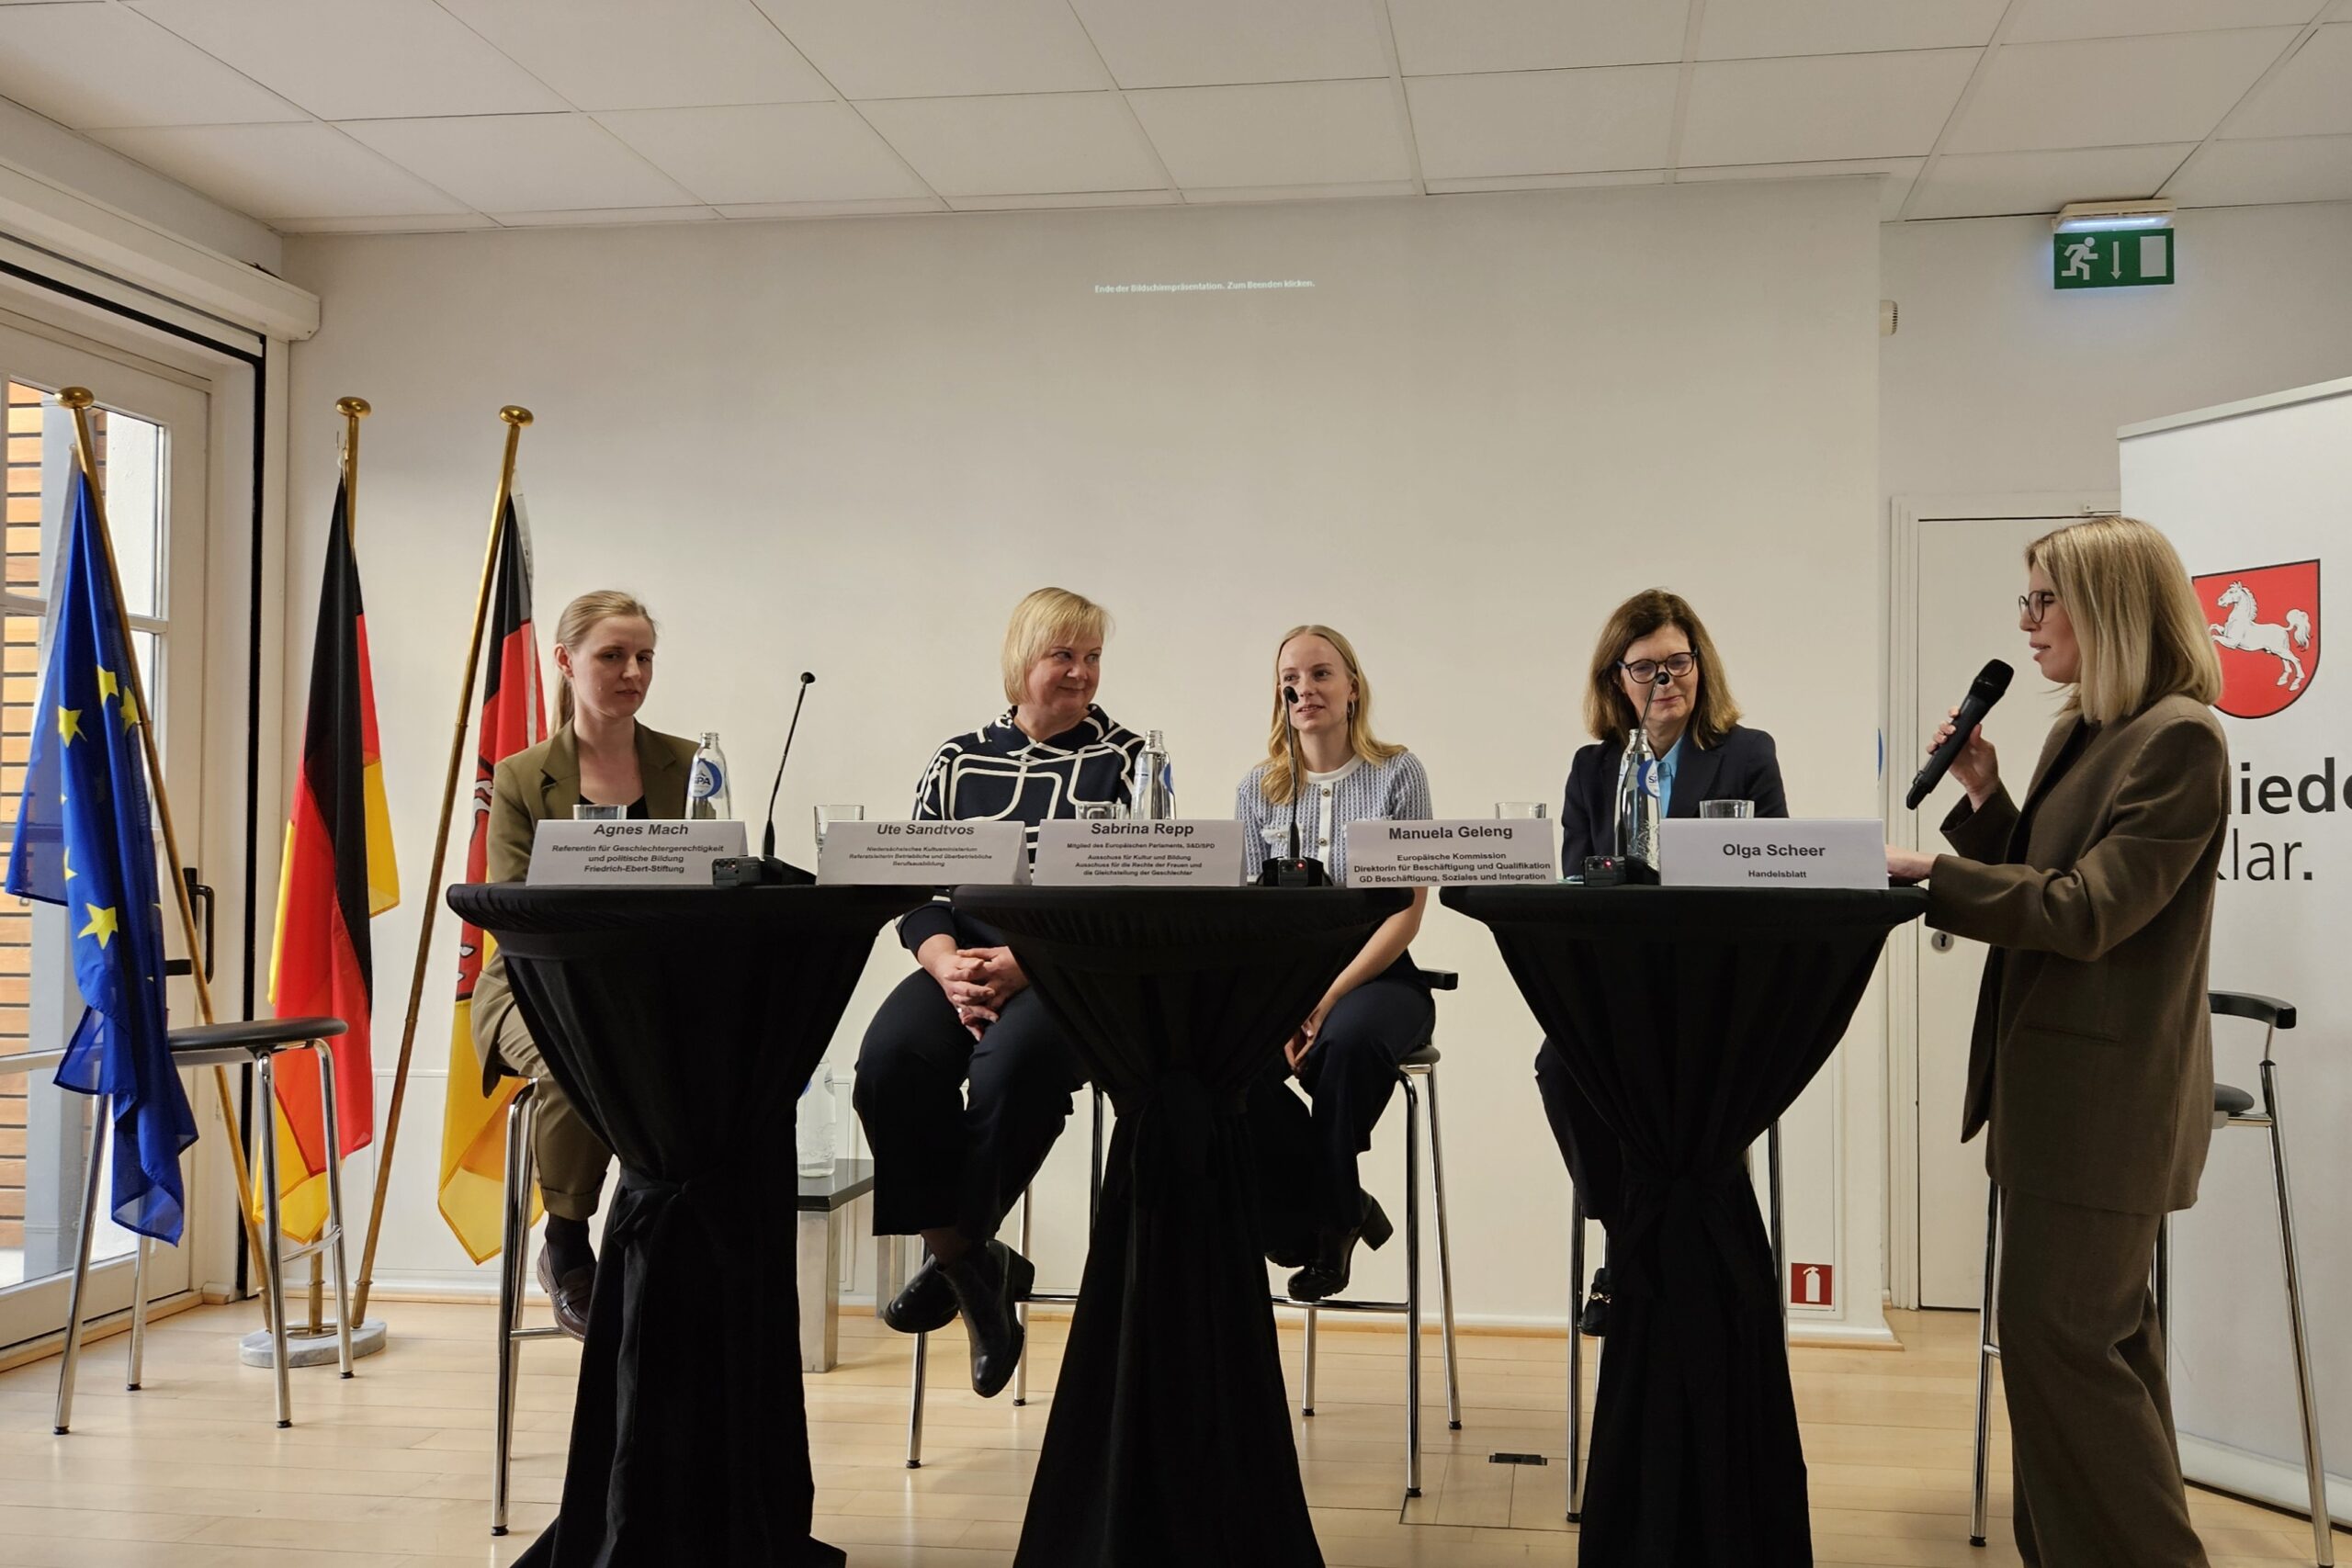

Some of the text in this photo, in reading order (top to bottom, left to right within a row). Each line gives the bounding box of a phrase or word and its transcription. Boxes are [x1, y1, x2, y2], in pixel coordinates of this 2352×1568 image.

[1094, 285, 1115, 293] Ende
[1227, 281, 1246, 290] Zum
[1247, 280, 1283, 289] Beenden
[1283, 279, 1315, 288] klicken.
[2228, 757, 2352, 815] ied
[594, 824, 688, 838] Agnes Mach
[877, 824, 975, 835] Ute Sandtvos
[1091, 823, 1194, 837] Sabrina Repp
[1389, 826, 1513, 840] Manuela Geleng
[1723, 844, 1826, 858] Olga Scheer
[2217, 829, 2312, 881] lar.
[607, 855, 649, 863] politische
[650, 855, 684, 863] Bildung
[1397, 854, 1451, 863] Europäische
[584, 865, 684, 874] Friedrich-Ebert-Stiftung
[1413, 863, 1475, 873] Beschäftigung
[1496, 862, 1550, 870] Qualifikation
[1375, 874, 1440, 884] Beschäftigung,
[1748, 870, 1807, 878] Handelsblatt
